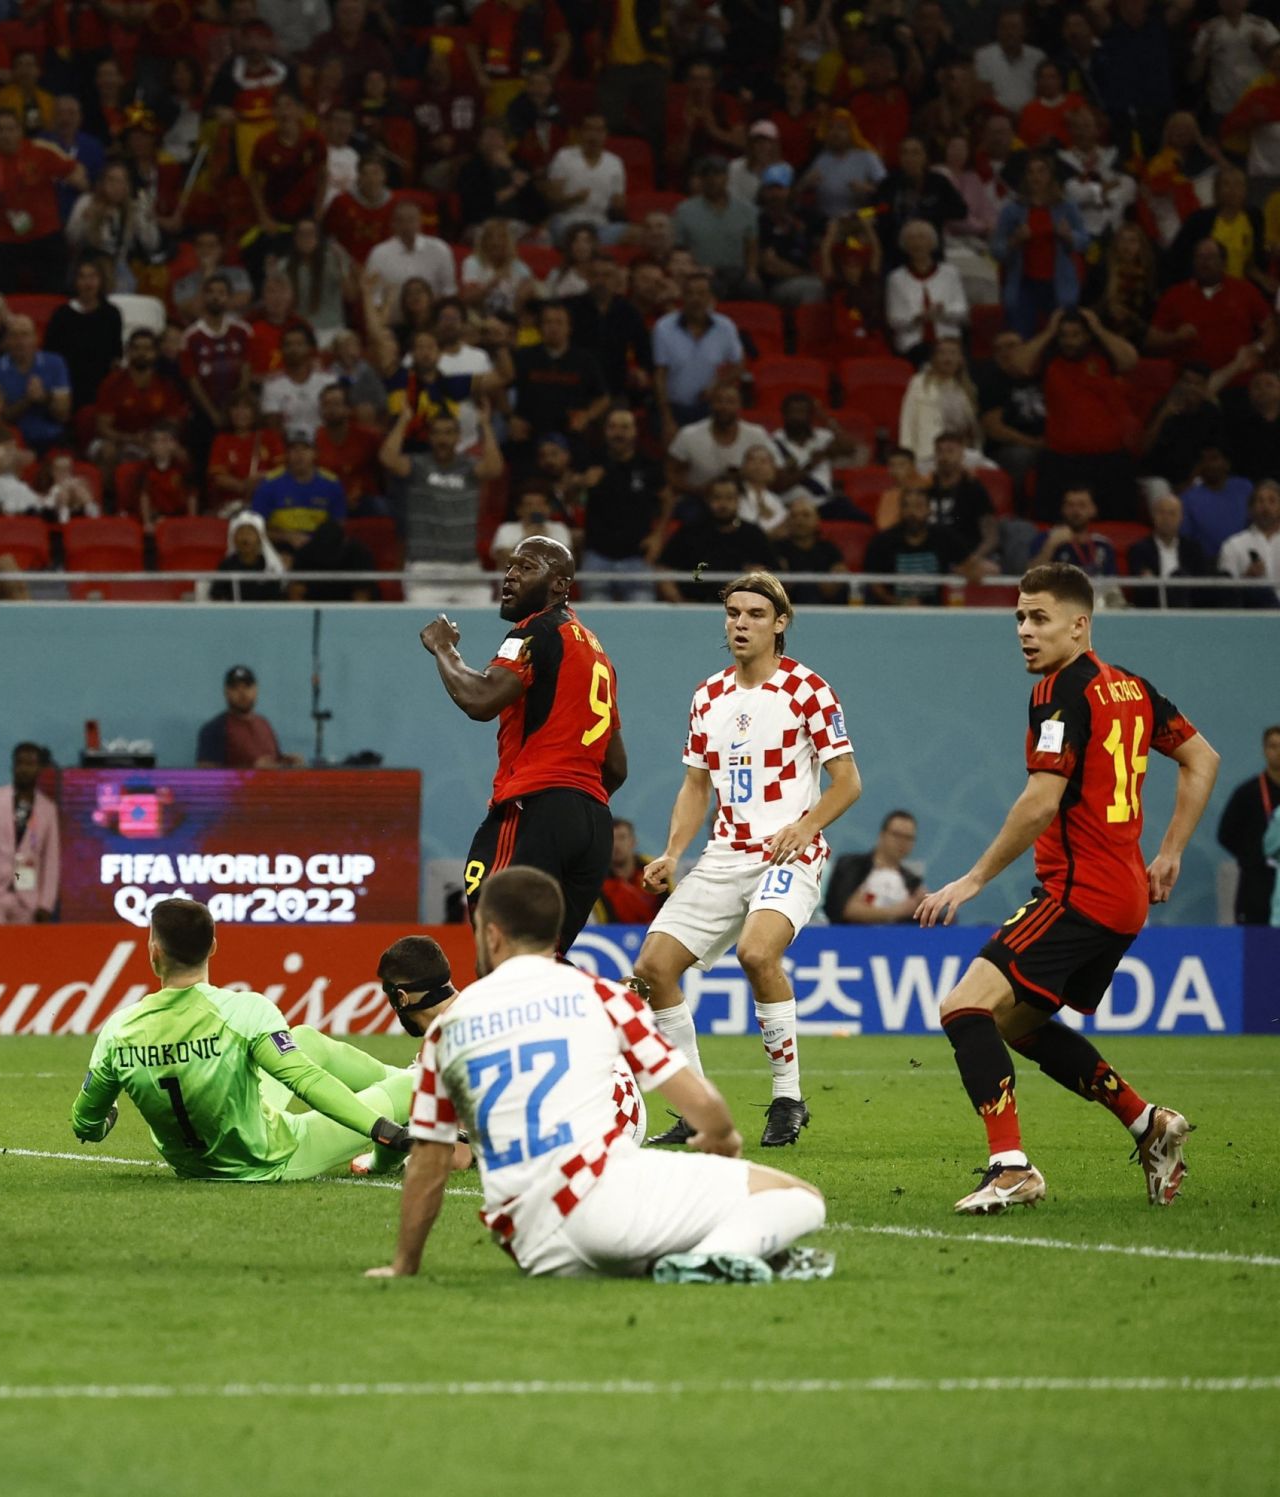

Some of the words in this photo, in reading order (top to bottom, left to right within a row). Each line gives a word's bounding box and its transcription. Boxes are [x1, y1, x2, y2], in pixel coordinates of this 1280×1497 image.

[581, 660, 612, 747] 9
[1093, 684, 1109, 706] T.
[729, 768, 753, 803] 19
[100, 853, 177, 885] FIFA
[176, 853, 304, 885] WORLD
[305, 853, 376, 885] CUP
[464, 859, 486, 896] 9
[761, 869, 794, 895] 19
[869, 955, 1226, 1032] WDA
[158, 1076, 210, 1150] 1
[466, 1038, 575, 1172] 22
